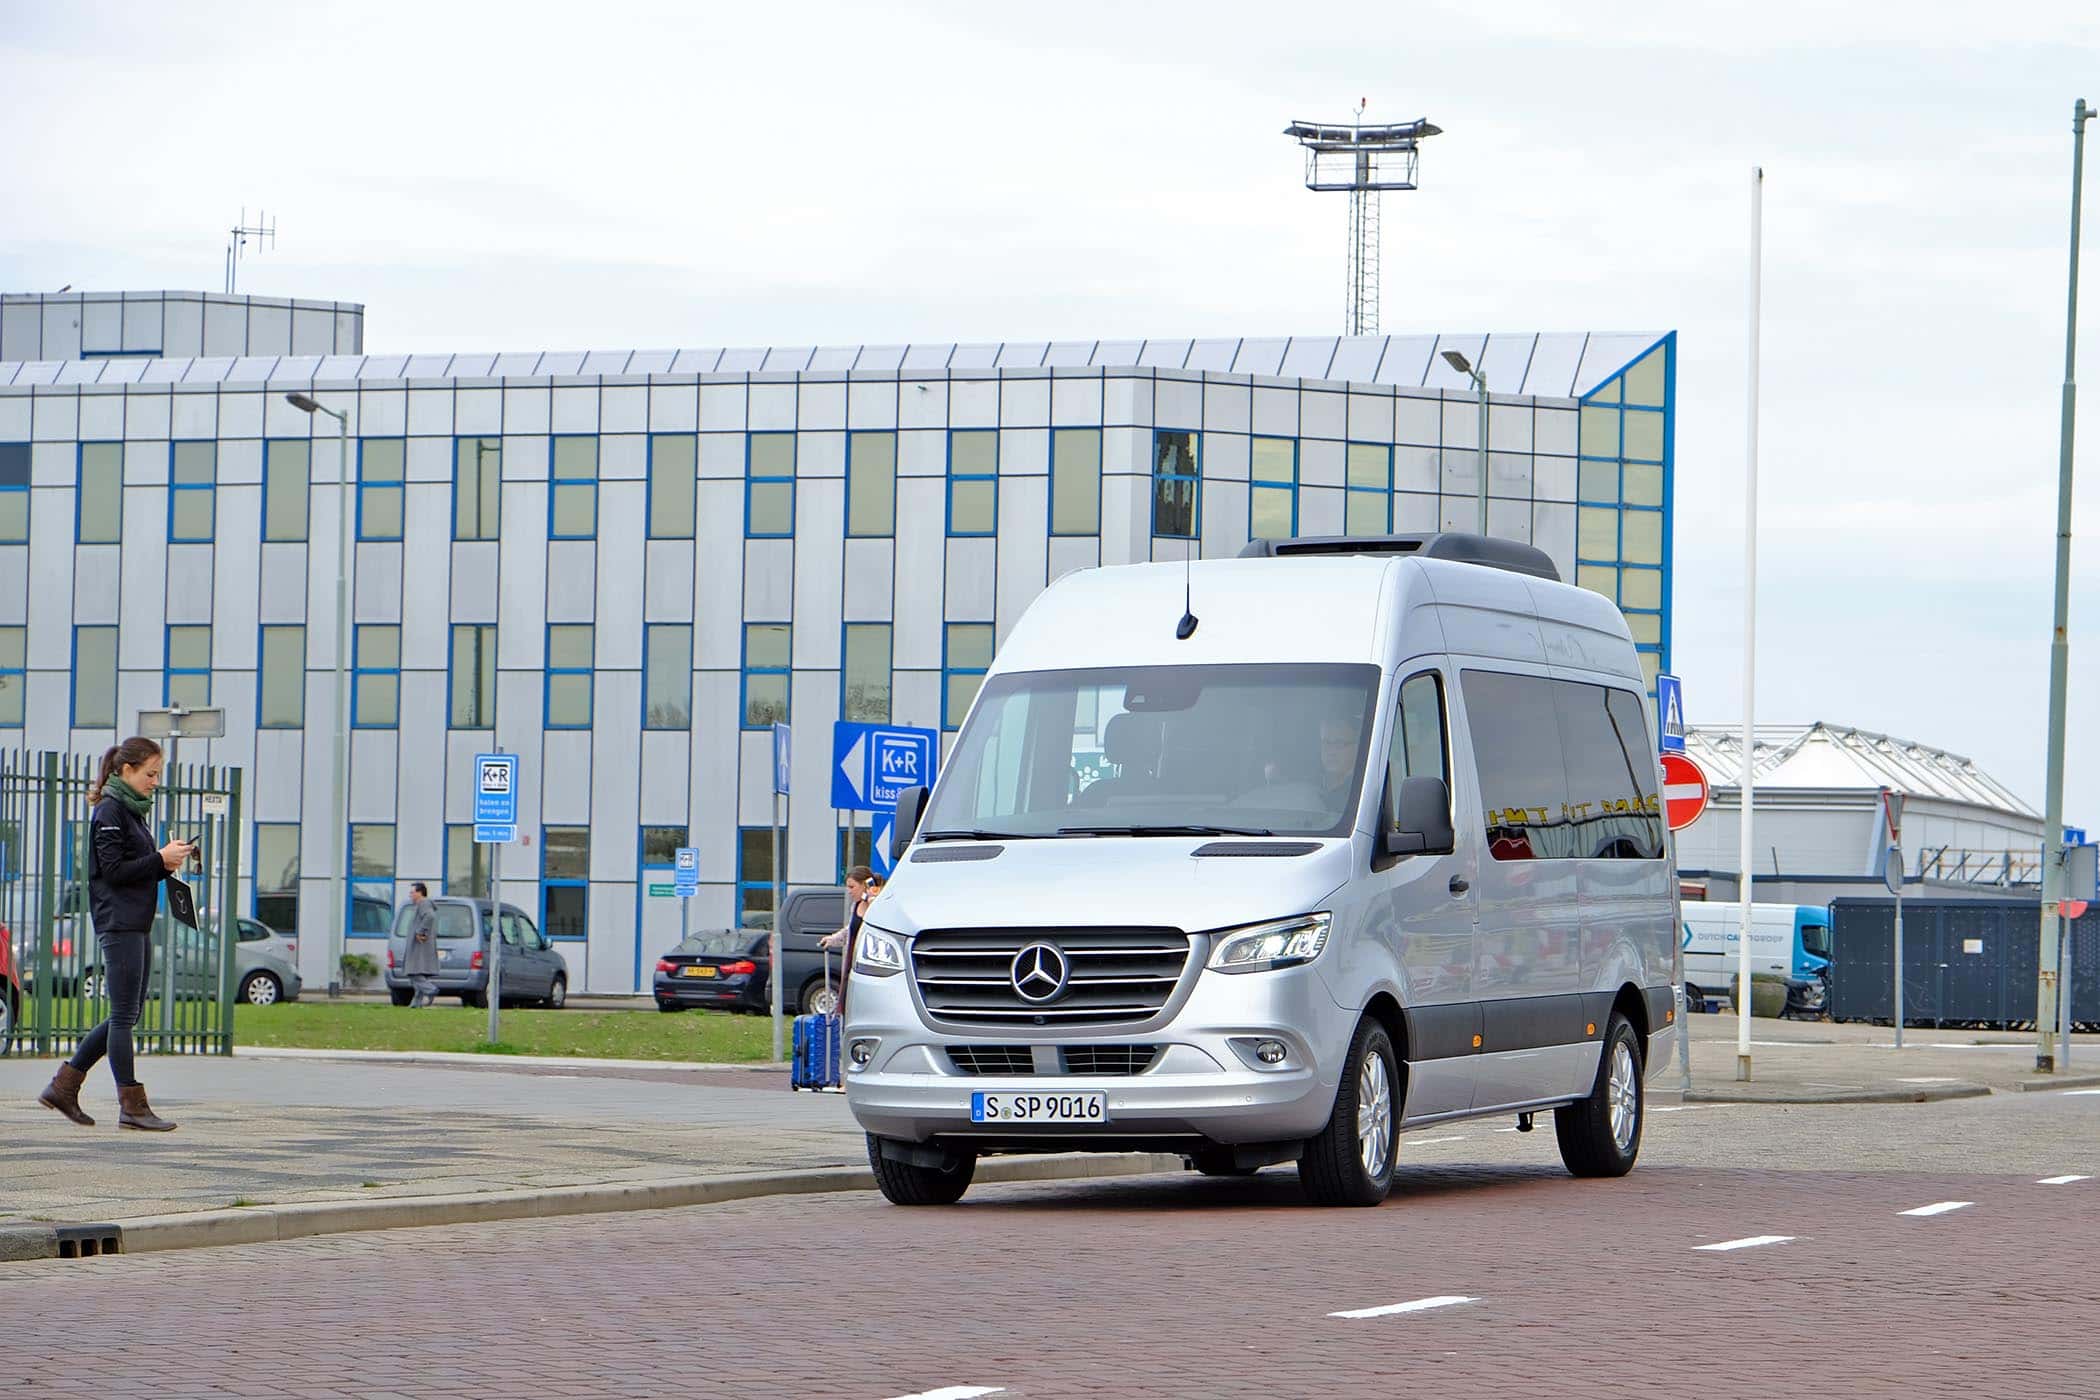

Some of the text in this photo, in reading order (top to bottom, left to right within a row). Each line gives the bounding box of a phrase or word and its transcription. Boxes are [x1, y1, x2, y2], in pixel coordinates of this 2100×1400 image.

[882, 749, 917, 775] K+R
[482, 768, 508, 782] K+R
[986, 1096, 1100, 1118] S SP 9016
